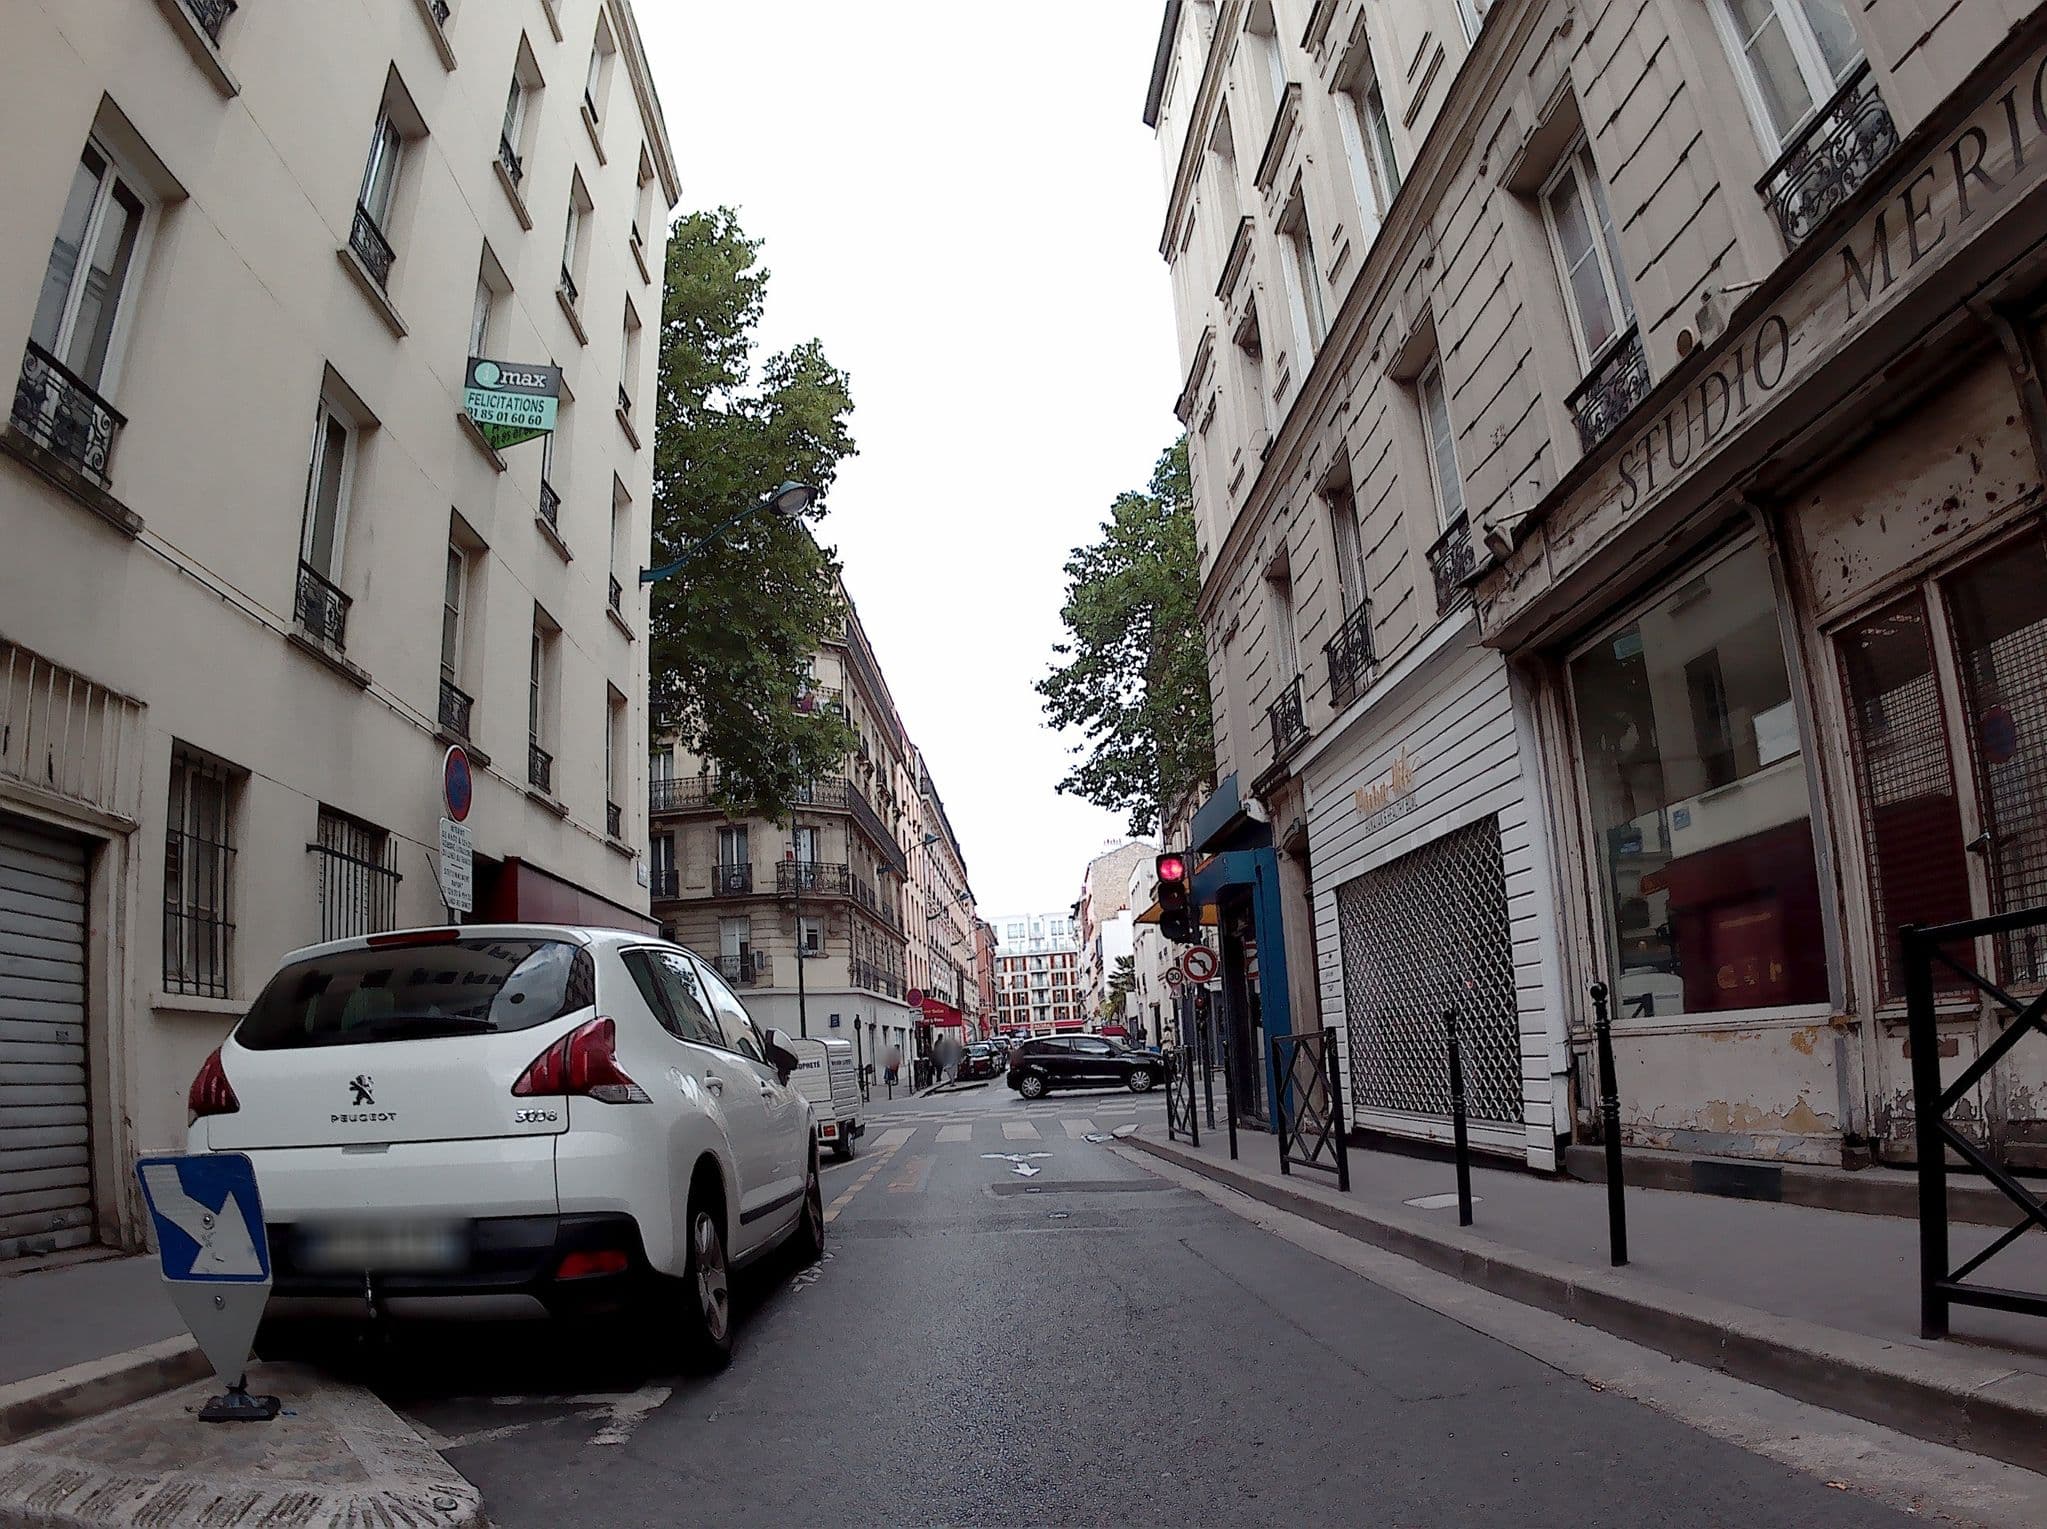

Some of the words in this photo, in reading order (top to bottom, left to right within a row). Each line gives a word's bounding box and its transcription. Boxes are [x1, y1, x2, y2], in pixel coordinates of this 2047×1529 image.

[468, 392, 545, 413] FELICITATIONS
[481, 408, 494, 420] 85
[496, 411, 508, 422] 01
[511, 412, 525, 424] 60
[528, 415, 542, 426] 60
[1617, 314, 1790, 513] STUDIO
[1169, 972, 1180, 981] 30
[330, 1112, 397, 1123] PEUGEOT
[515, 1108, 558, 1123] 3008
